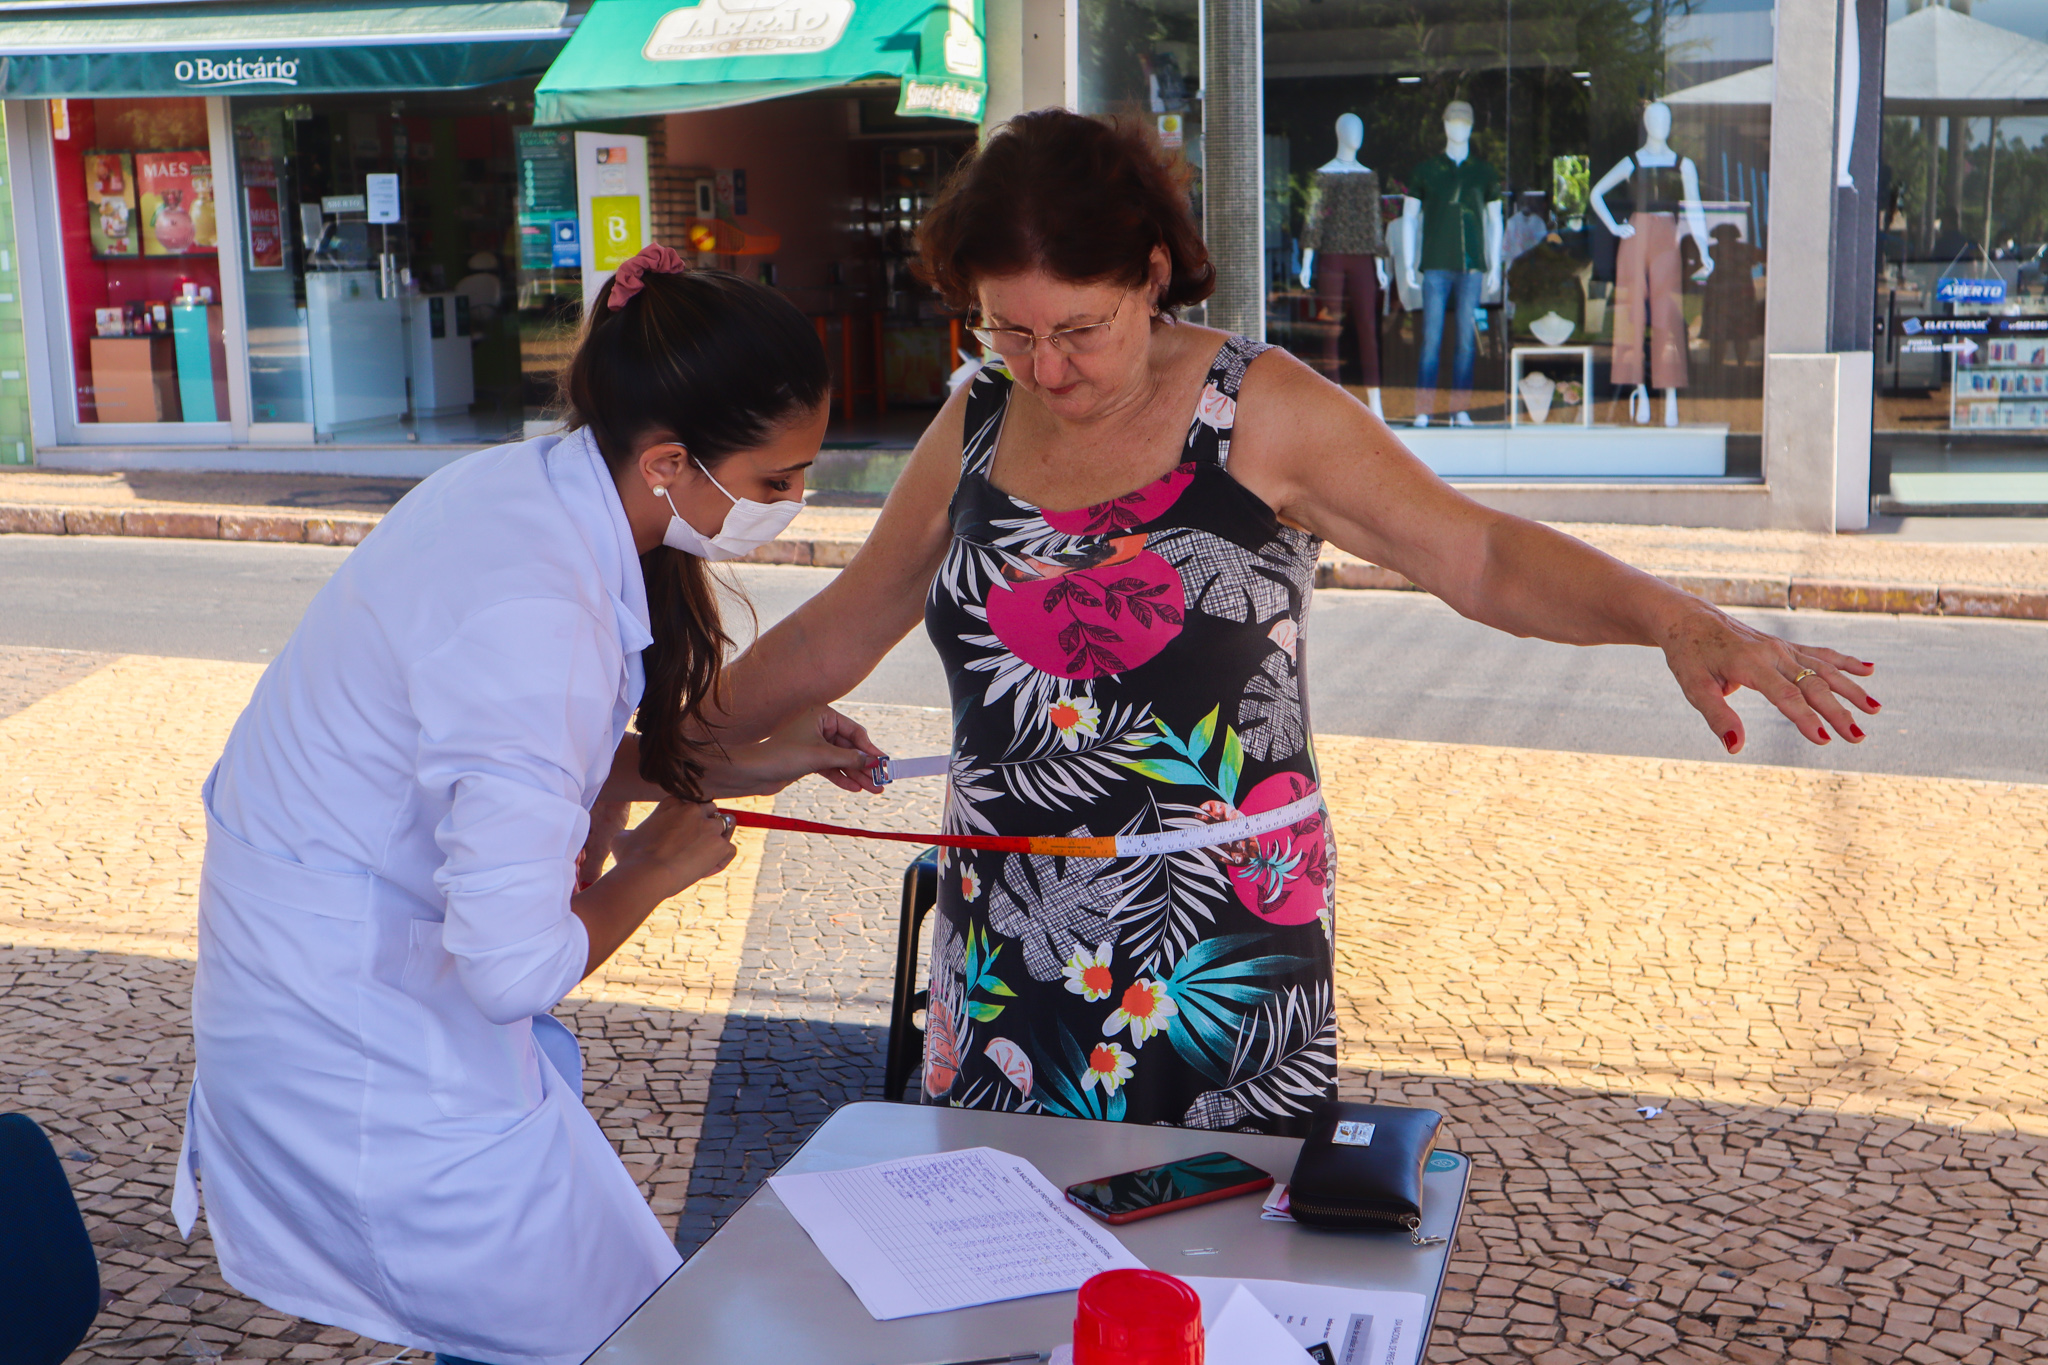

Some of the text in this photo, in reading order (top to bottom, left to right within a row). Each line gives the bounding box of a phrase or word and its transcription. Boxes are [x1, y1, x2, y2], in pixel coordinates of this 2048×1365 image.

[736, 36, 826, 50] Salgados
[174, 56, 298, 81] O Boticário
[905, 80, 936, 109] Sucos
[938, 82, 981, 115] Salgados
[607, 216, 628, 242] B
[1940, 284, 2003, 298] ABERTO
